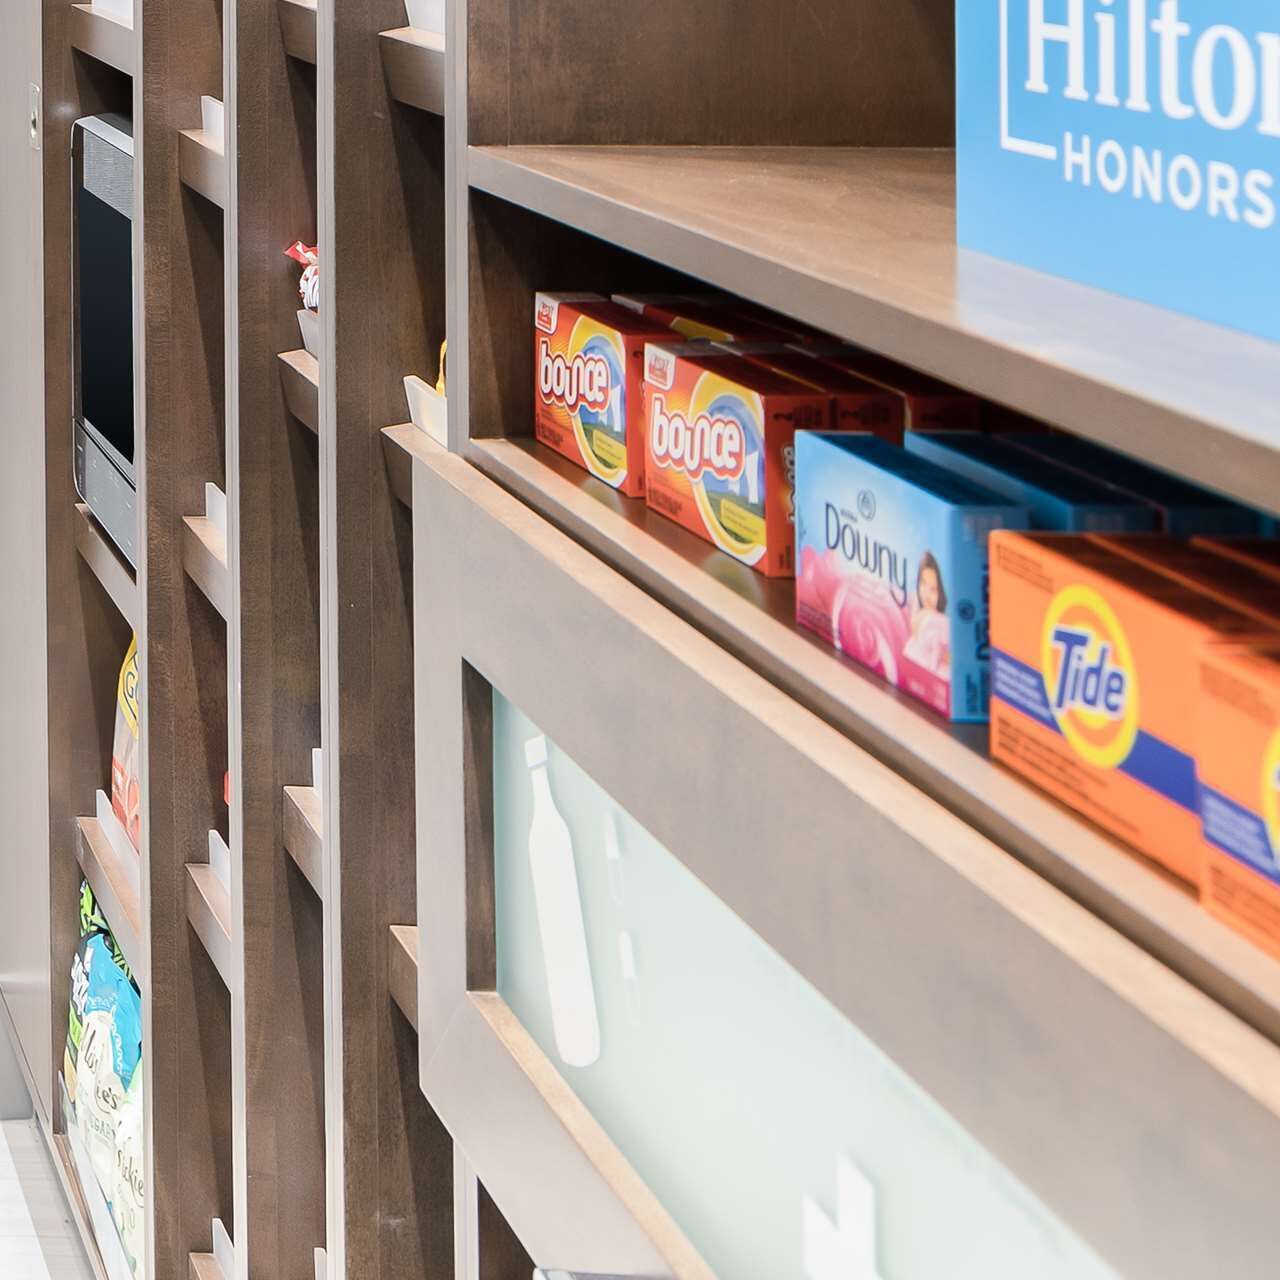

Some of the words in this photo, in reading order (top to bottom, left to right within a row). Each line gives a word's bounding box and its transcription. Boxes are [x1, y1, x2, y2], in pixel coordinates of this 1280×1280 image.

[1062, 131, 1276, 230] HONORS
[540, 339, 609, 410] bounce
[651, 396, 743, 477] bounce
[824, 502, 908, 608] Downy
[1051, 628, 1127, 714] Tide
